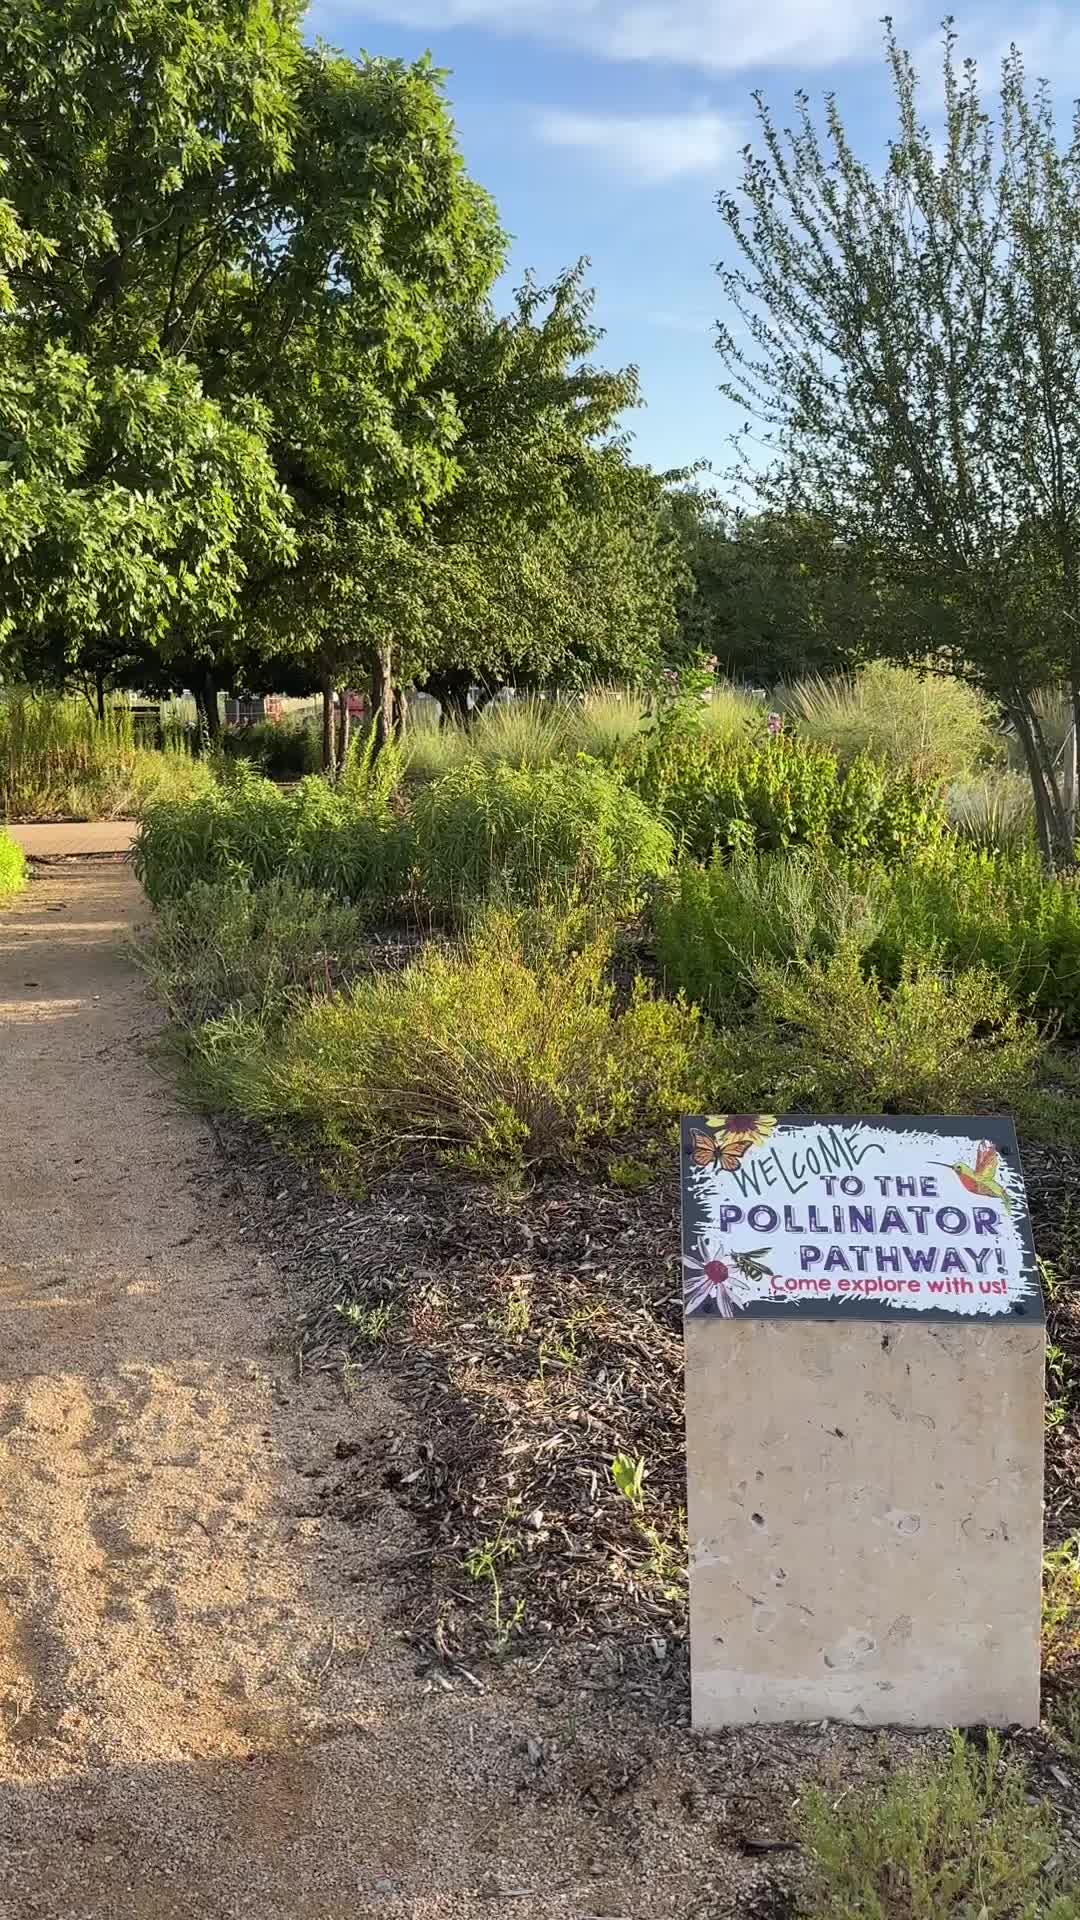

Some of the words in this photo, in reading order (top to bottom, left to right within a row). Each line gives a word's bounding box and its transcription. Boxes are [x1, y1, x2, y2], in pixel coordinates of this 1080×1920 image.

[732, 1127, 886, 1198] WELCOME
[820, 1175, 865, 1198] TO
[874, 1175, 939, 1198] THE
[719, 1203, 1002, 1236] POLLINATOR
[799, 1244, 1009, 1275] PATHWAY!
[770, 1274, 832, 1293] Come
[837, 1276, 921, 1295] explore
[927, 1277, 973, 1295] with
[979, 1278, 1009, 1295] us!
